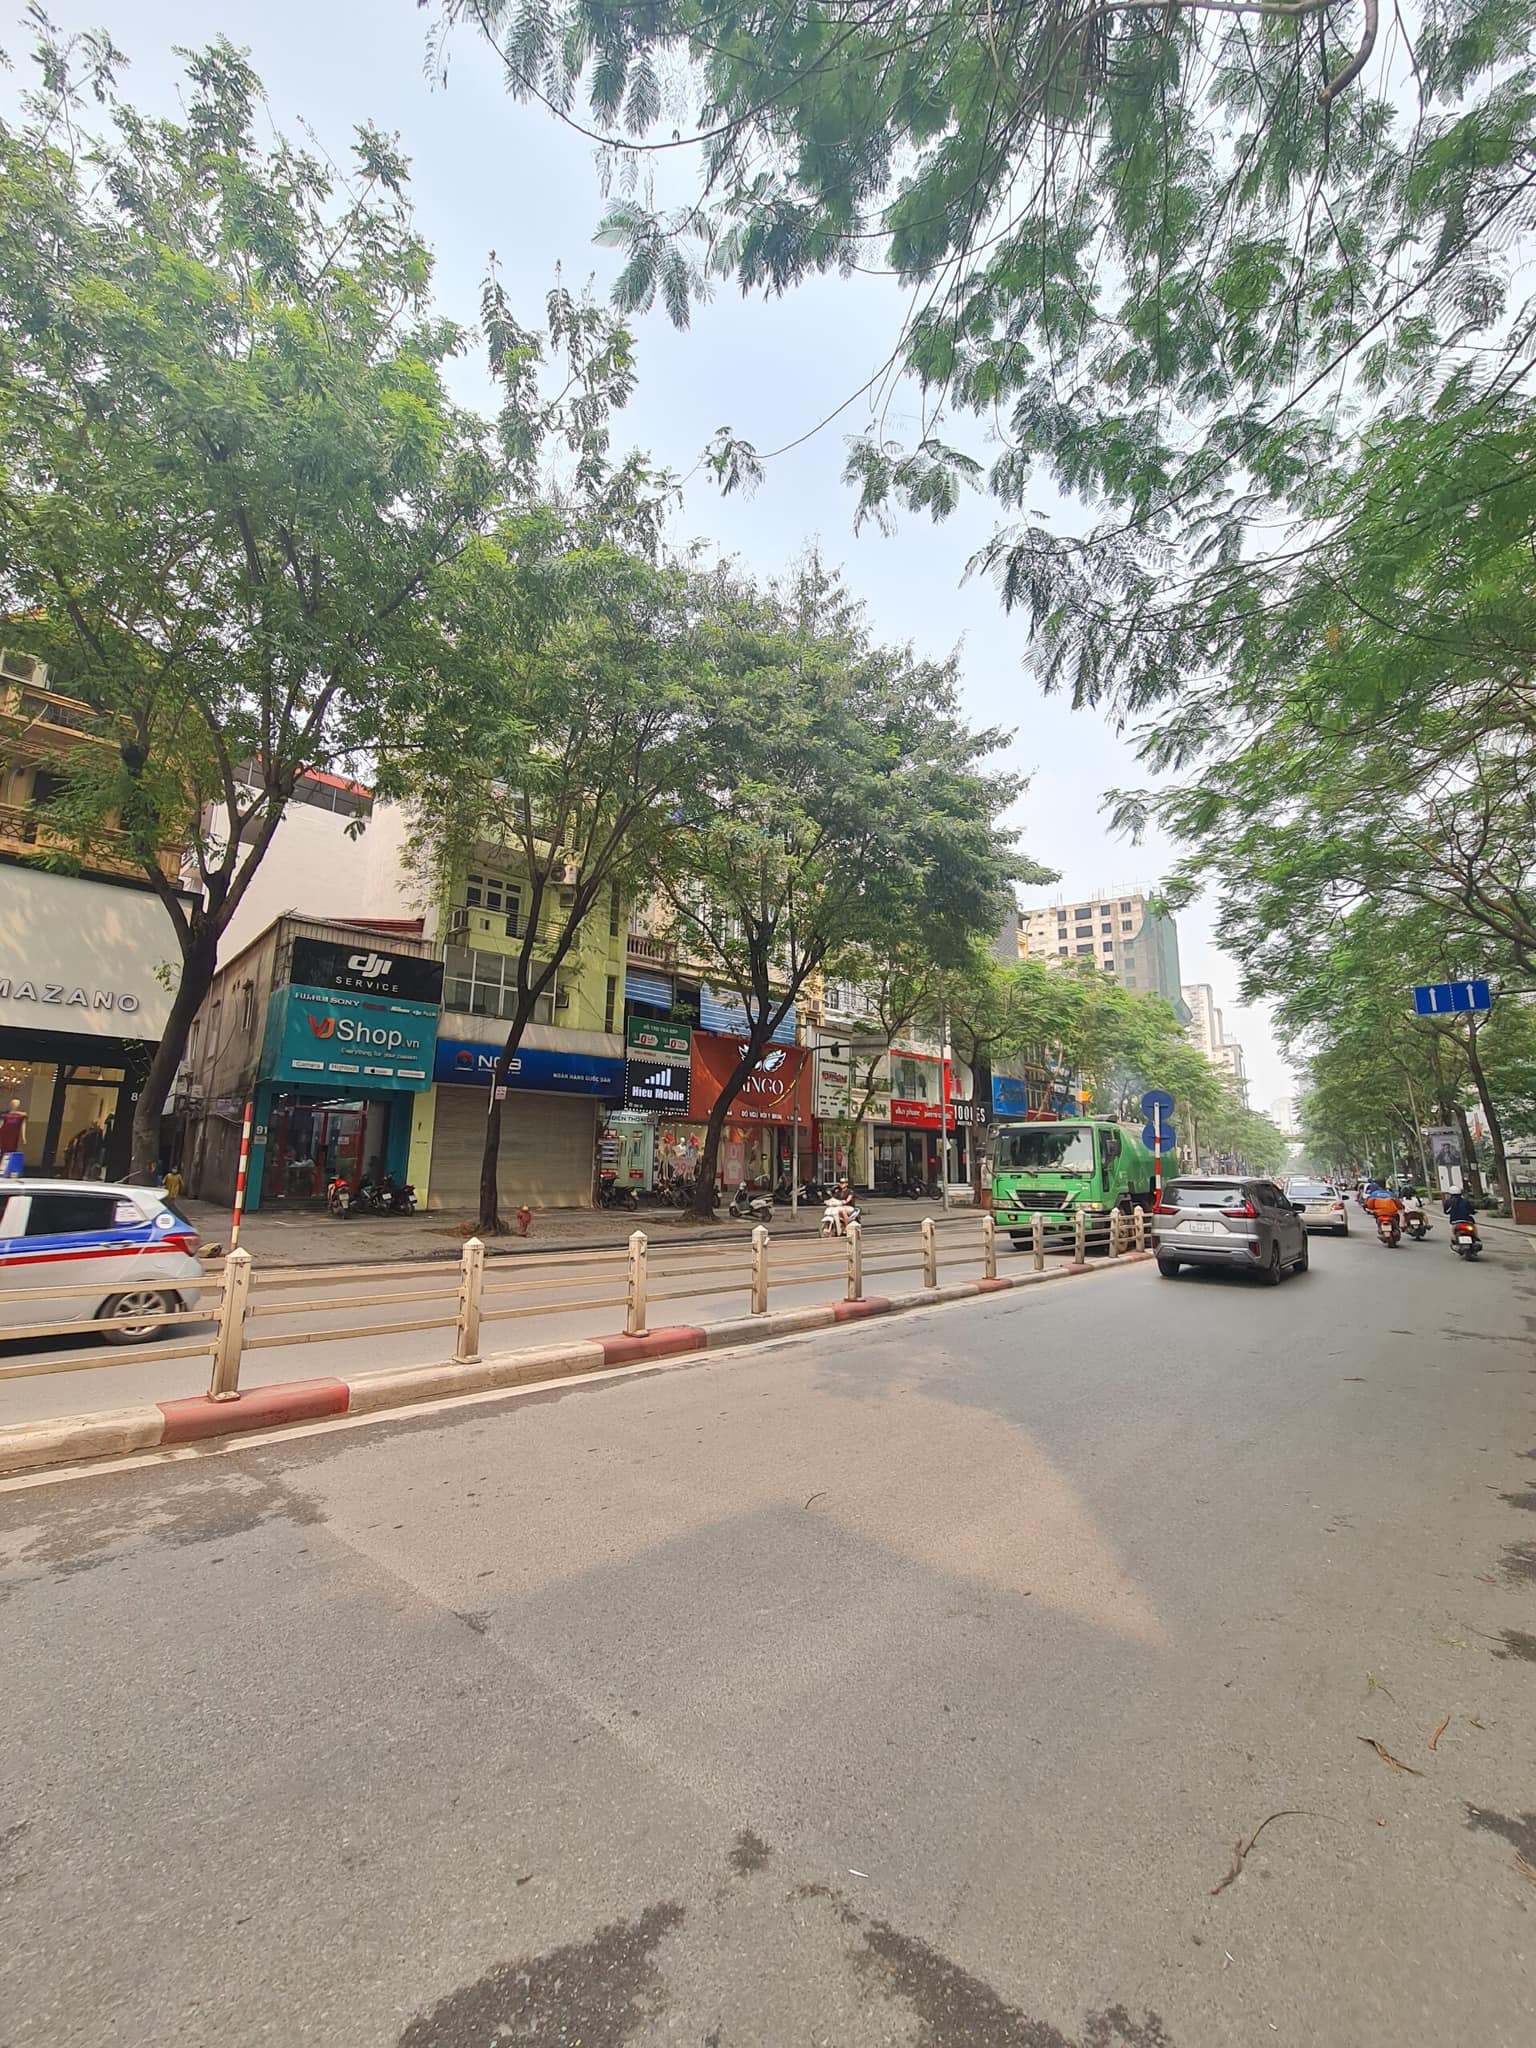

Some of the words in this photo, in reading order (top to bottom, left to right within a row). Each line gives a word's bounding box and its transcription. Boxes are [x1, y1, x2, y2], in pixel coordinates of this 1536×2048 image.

[335, 975, 401, 993] SERVICE
[654, 1088, 685, 1101] Mobile
[256, 1125, 268, 1135] 91
